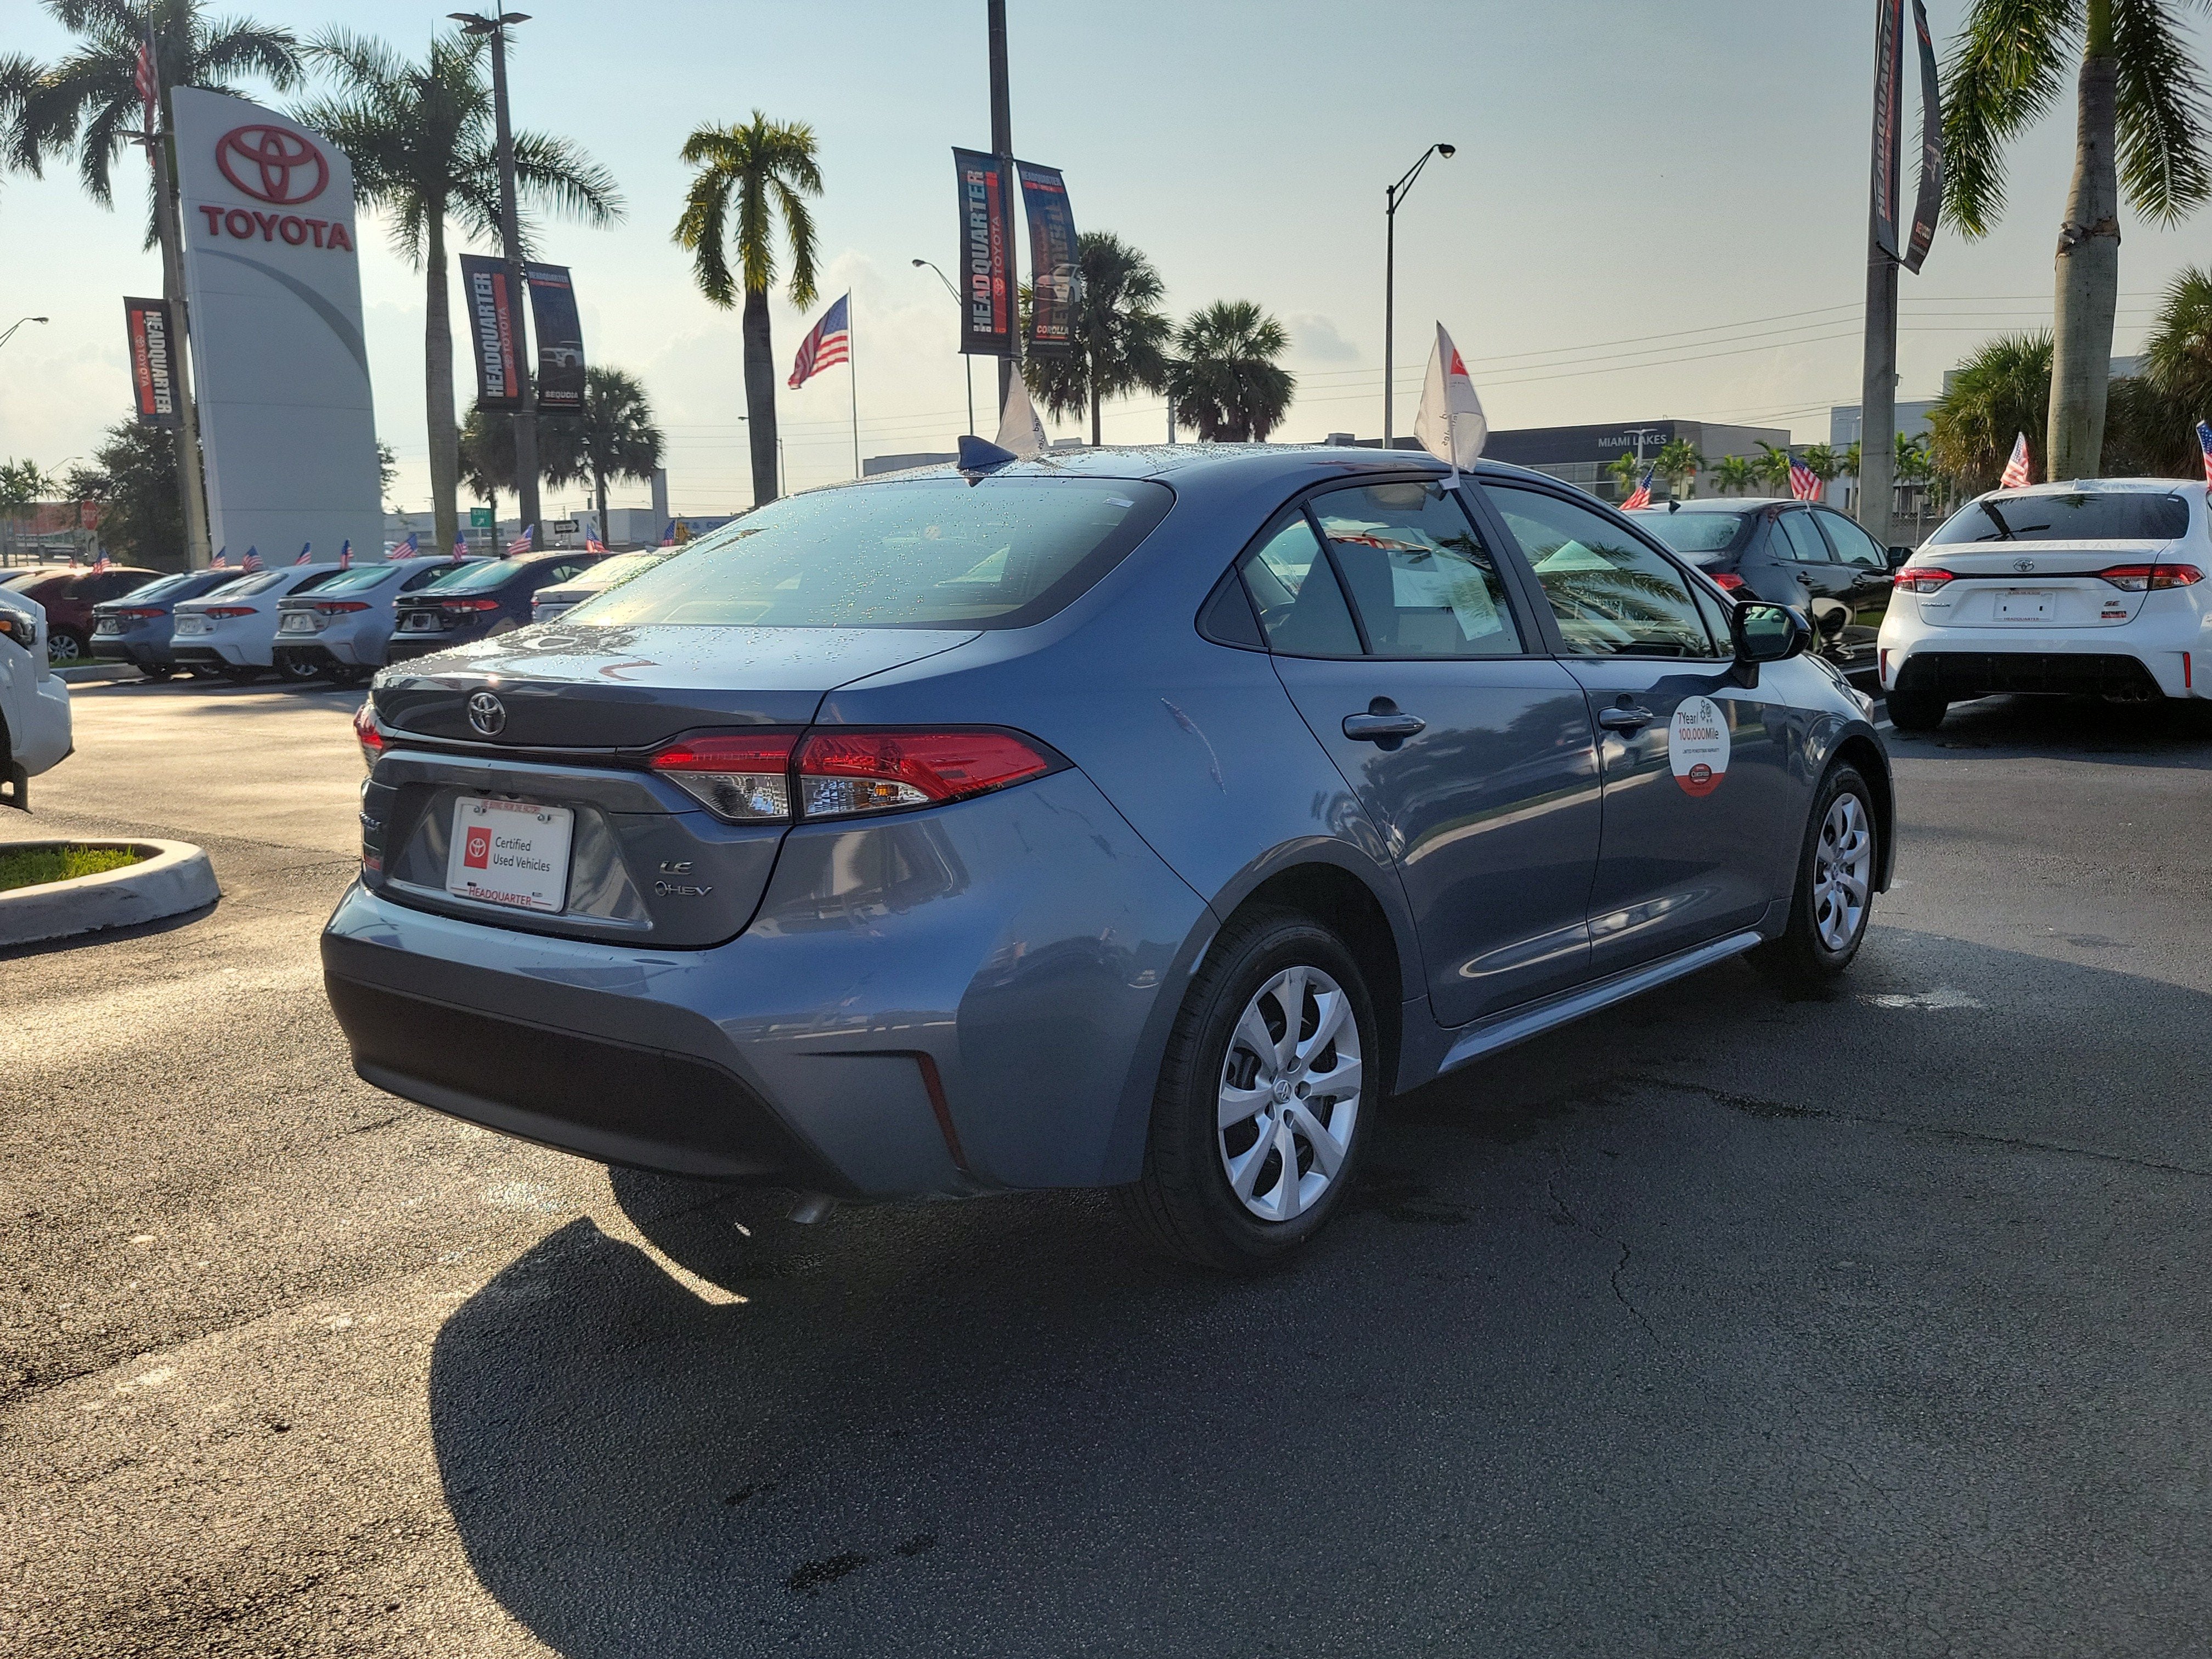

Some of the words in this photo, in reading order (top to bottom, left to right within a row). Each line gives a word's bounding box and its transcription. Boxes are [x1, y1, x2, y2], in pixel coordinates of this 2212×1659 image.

[1877, 0, 1893, 219] HEADQUARTE
[199, 205, 353, 252] TOYOTA
[991, 216, 1003, 276] TOYOTA
[967, 171, 992, 333] HEADQUARTER
[473, 273, 504, 397] HEADQUARTER
[498, 307, 511, 353] TOYOTA
[1036, 325, 1069, 335] COROLLA
[137, 346, 149, 387] TOYOTA
[145, 311, 172, 414] HEADQUARTER
[1598, 436, 1630, 448] MIAMI
[1633, 434, 1667, 445] LAKES
[1679, 727, 1719, 742] 100,000Mile
[494, 854, 514, 867] Used
[516, 856, 550, 872] Vehicles
[495, 837, 532, 851] Certified
[659, 860, 693, 875] LE
[469, 886, 532, 906] HEADQUARTER
